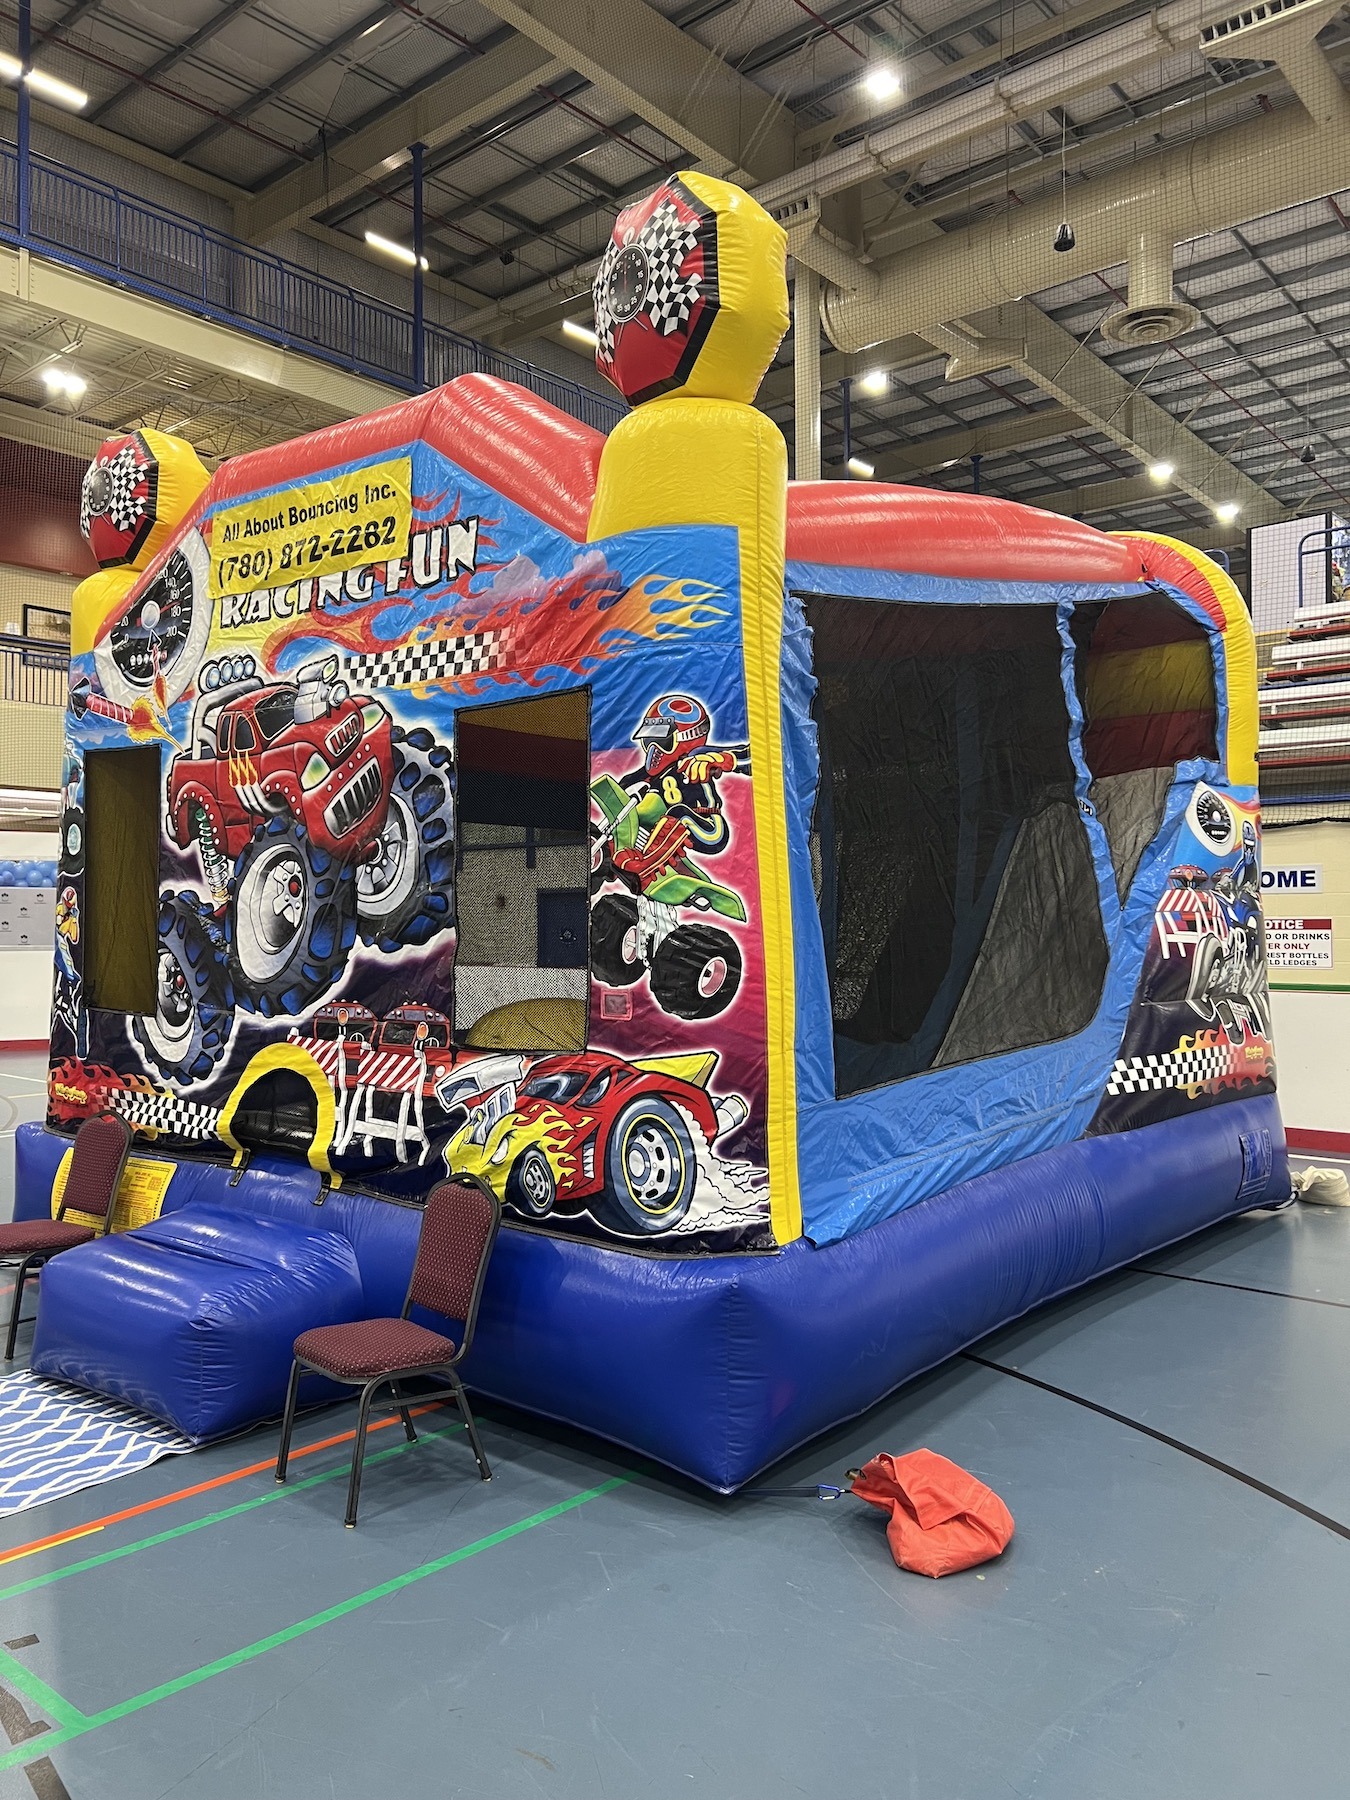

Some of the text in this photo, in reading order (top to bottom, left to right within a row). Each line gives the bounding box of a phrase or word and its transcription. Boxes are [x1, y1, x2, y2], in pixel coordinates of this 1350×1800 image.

[222, 483, 397, 544] All About Bouncing Inc.
[218, 516, 397, 589] (780) 872-2282
[384, 514, 480, 597] FUN
[662, 775, 683, 805] 8
